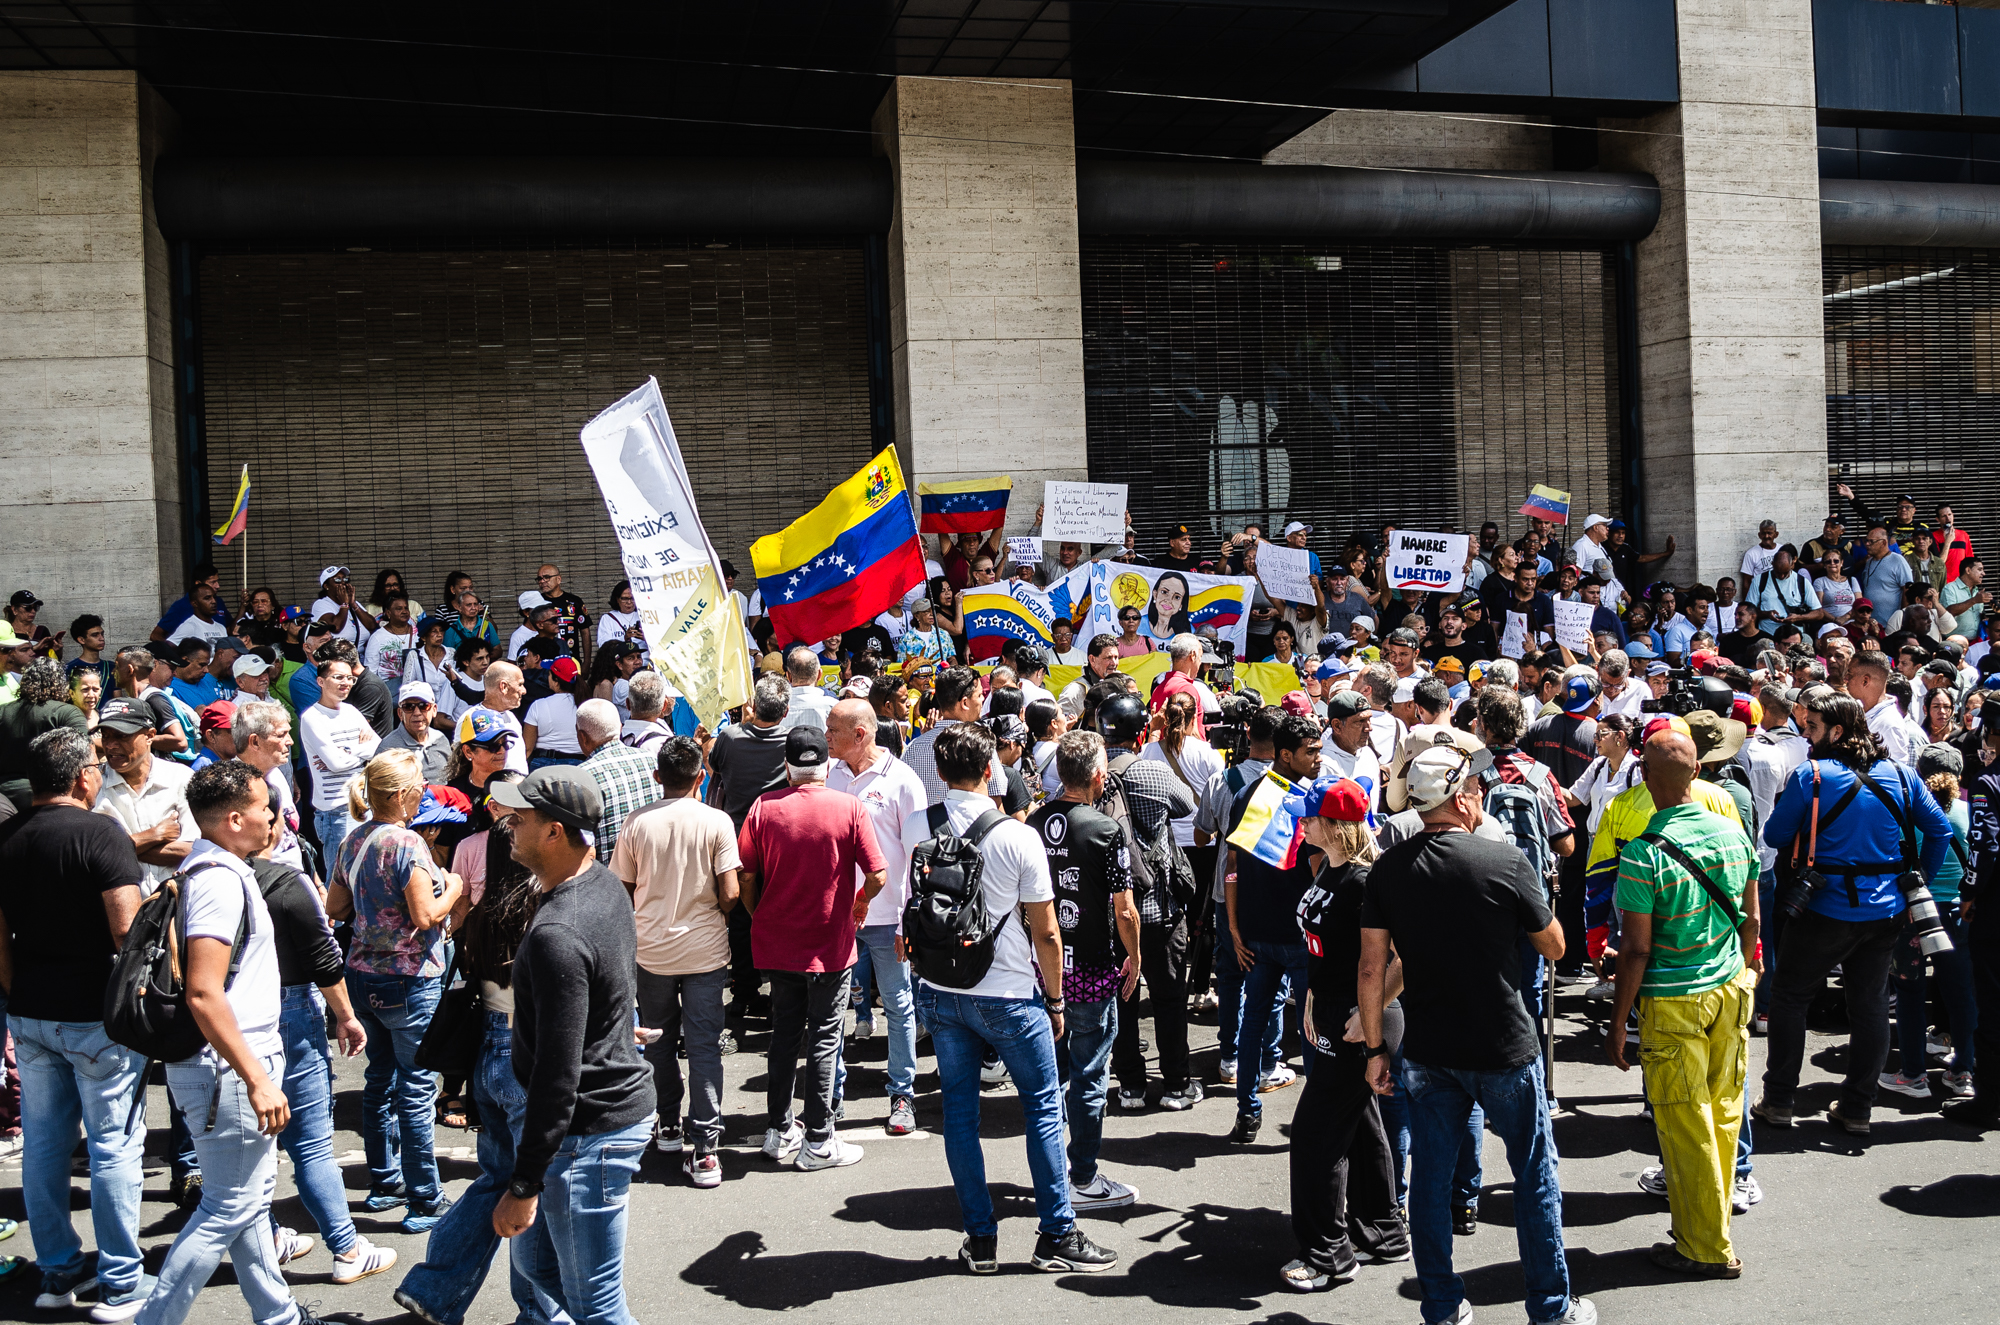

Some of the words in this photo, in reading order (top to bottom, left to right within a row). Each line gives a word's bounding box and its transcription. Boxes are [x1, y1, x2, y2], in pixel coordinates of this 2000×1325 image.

[1393, 565, 1452, 581] LIBERTAD
[1415, 554, 1434, 566] DE
[678, 598, 707, 635] VALLE
[1009, 581, 1054, 630] Venezuel
